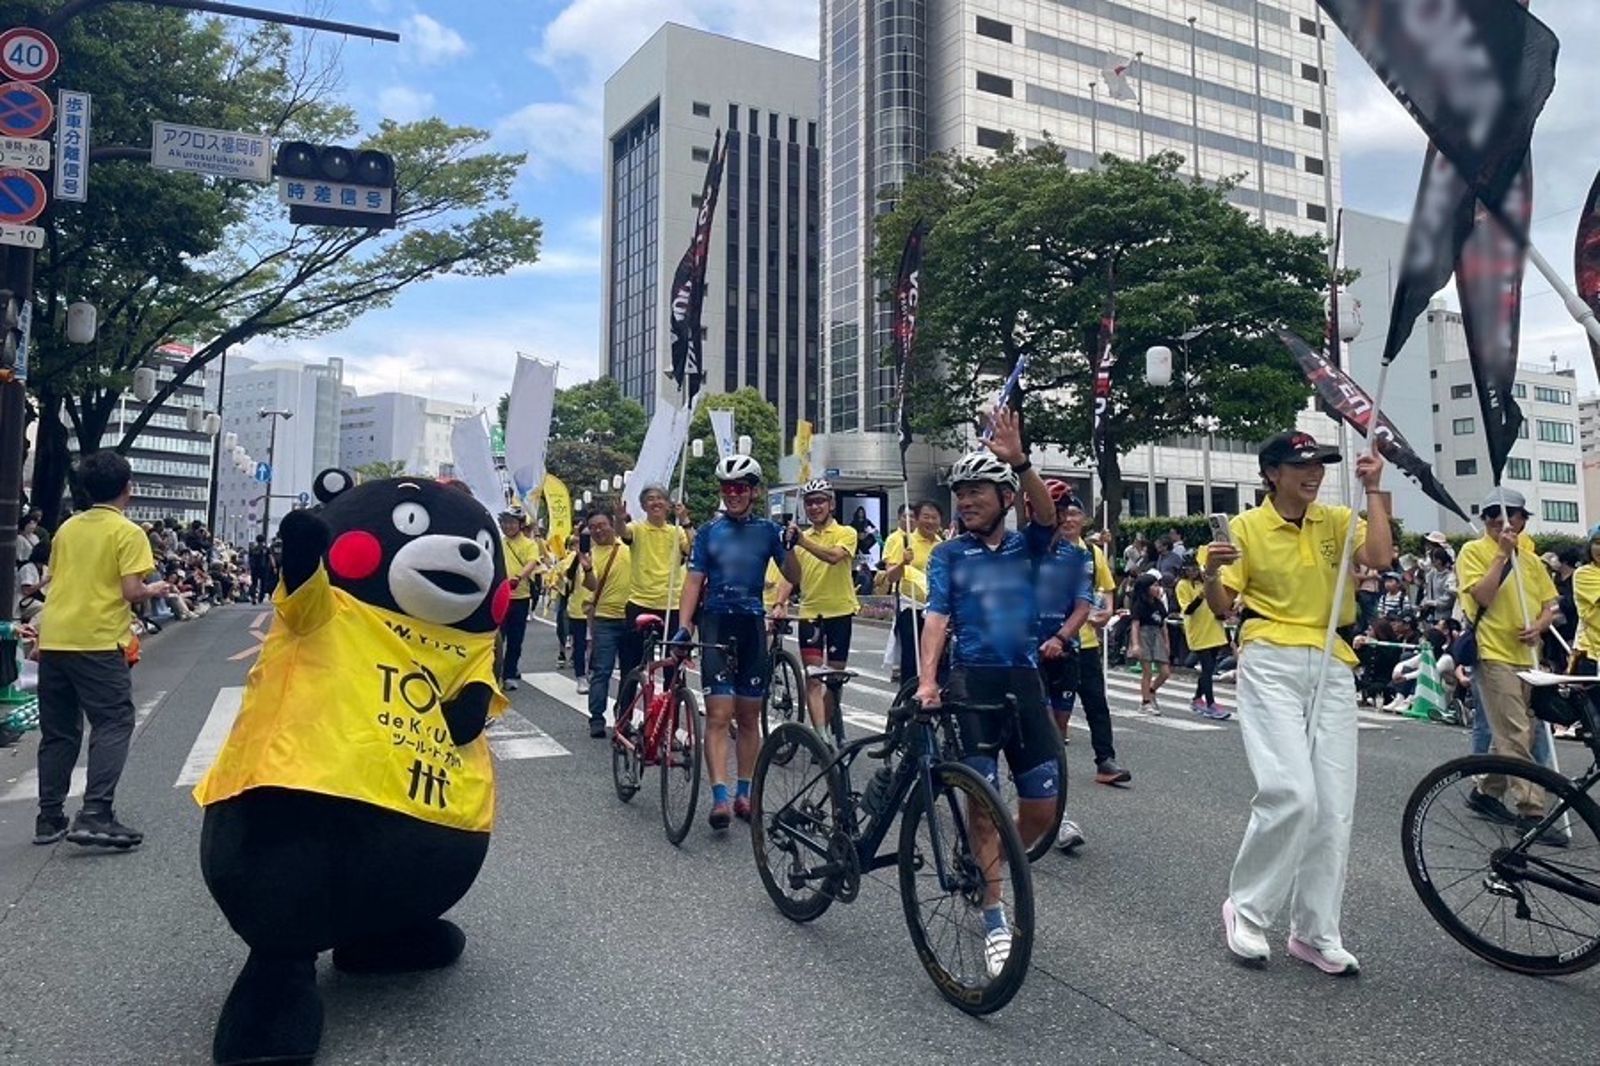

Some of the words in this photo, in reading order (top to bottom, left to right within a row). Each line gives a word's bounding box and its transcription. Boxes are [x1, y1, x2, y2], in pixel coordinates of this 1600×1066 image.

[9, 42, 43, 68] 40
[63, 97, 83, 194] 歩車分離信号
[163, 129, 263, 157] アクロス福岡前
[287, 182, 382, 209] 時差信号
